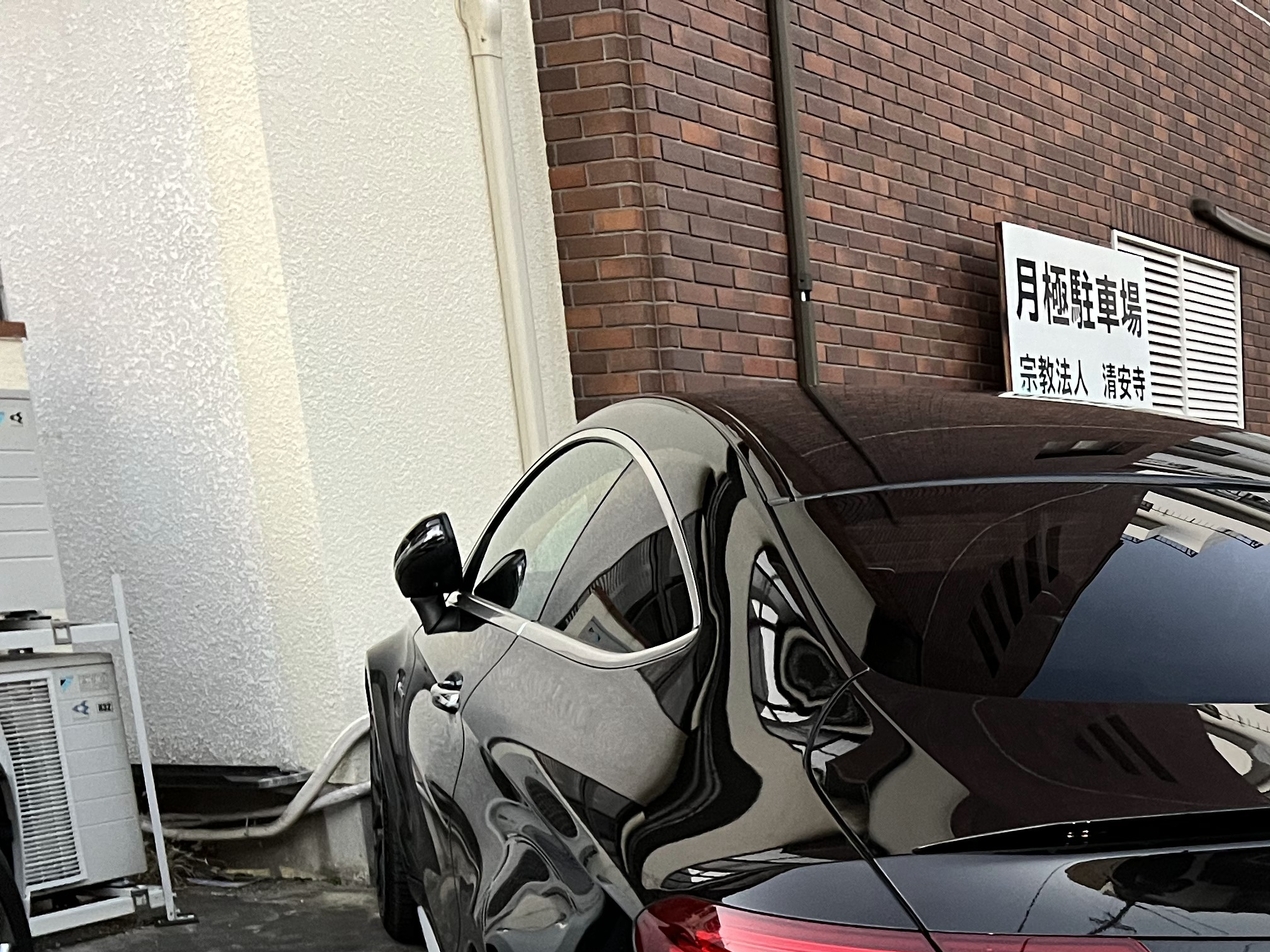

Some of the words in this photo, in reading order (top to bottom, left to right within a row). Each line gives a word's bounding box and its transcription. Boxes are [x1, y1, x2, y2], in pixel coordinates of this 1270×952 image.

[1016, 257, 1143, 338] 月極駐車場
[1019, 353, 1089, 397] 宗教法人
[1101, 362, 1146, 401] 清安寺
